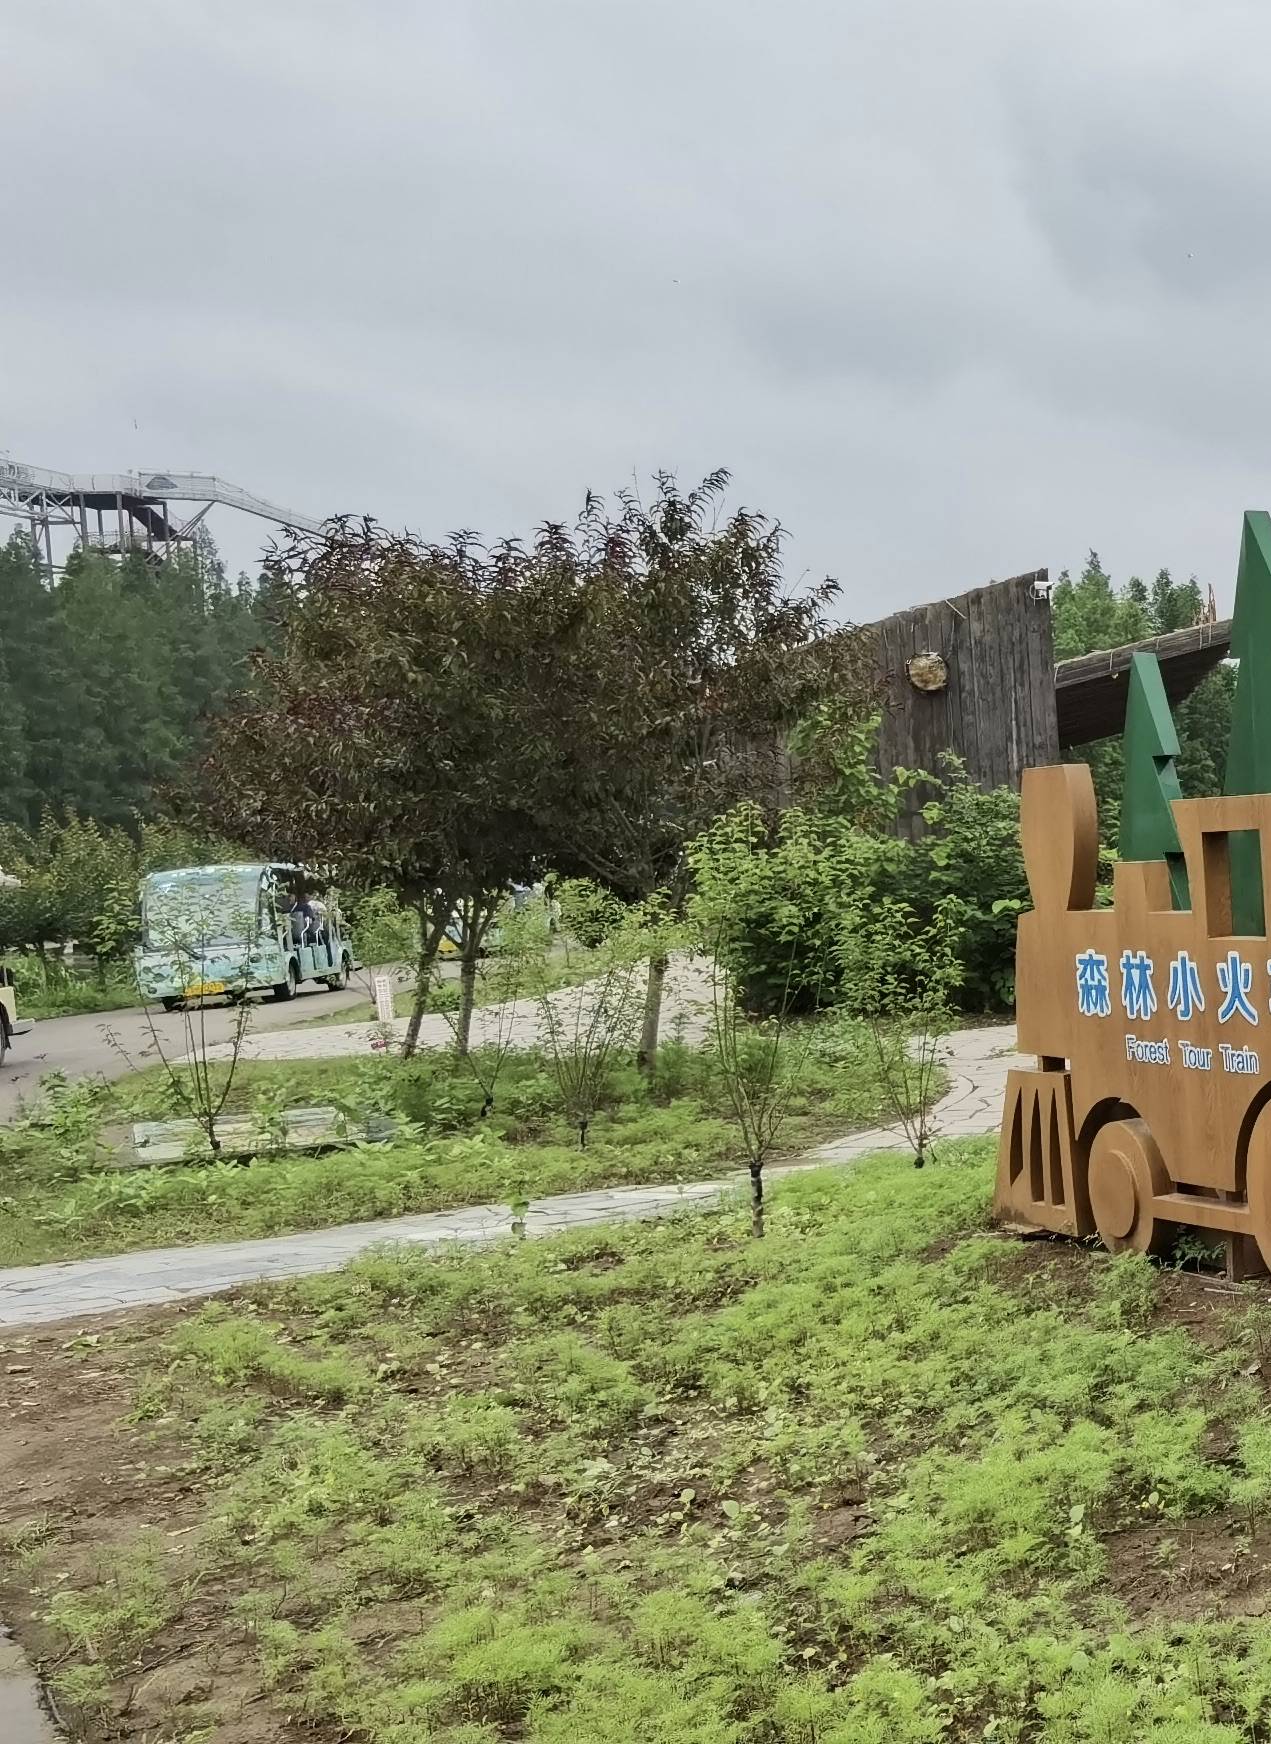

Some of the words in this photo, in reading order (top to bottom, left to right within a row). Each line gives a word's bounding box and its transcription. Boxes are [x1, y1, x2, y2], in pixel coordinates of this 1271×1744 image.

[1125, 1034, 1170, 1065] Forest
[1180, 1040, 1212, 1072] Tour
[1220, 1043, 1260, 1074] Train
